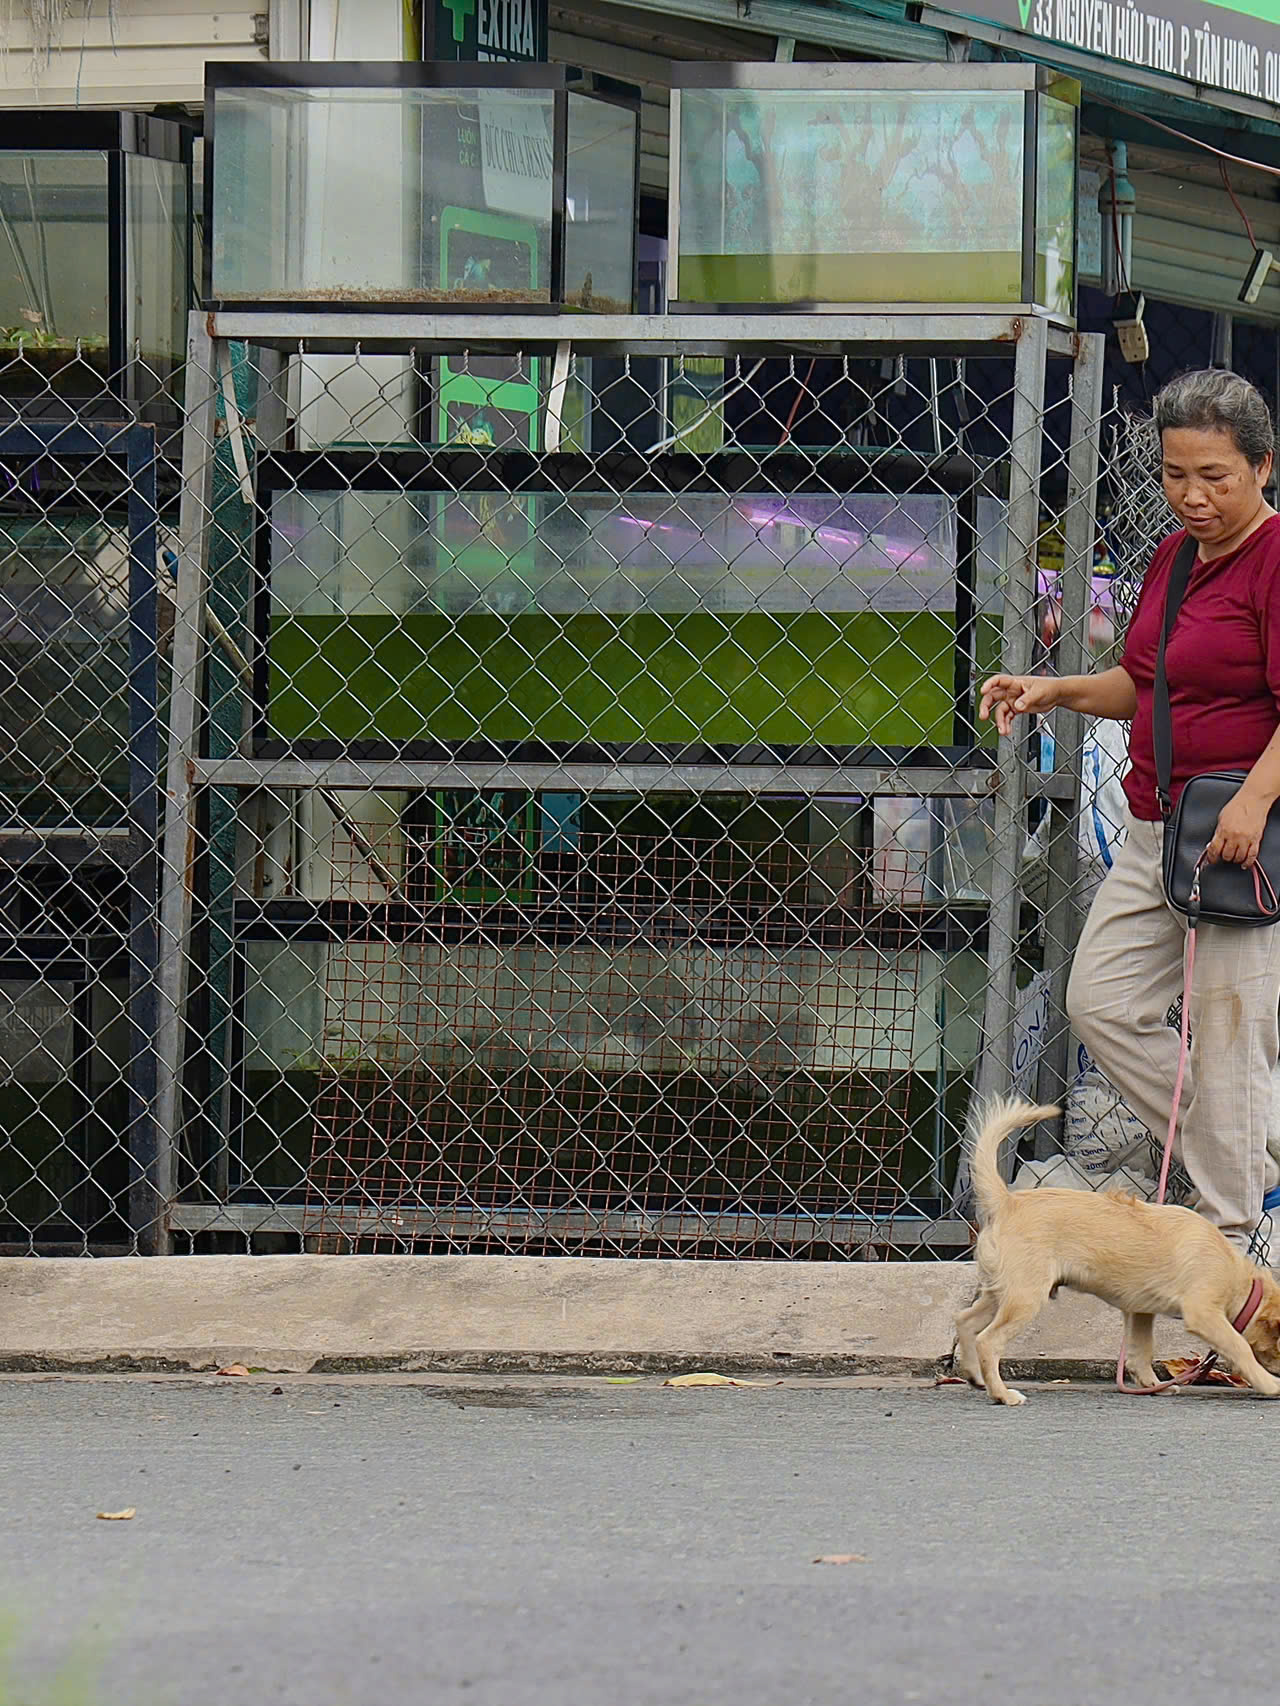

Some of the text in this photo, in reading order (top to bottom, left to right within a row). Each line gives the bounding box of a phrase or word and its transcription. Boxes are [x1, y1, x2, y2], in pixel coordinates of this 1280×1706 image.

[477, 0, 535, 57] EXTRA
[1033, 0, 1053, 38] 33
[1195, 21, 1221, 86] TÂN
